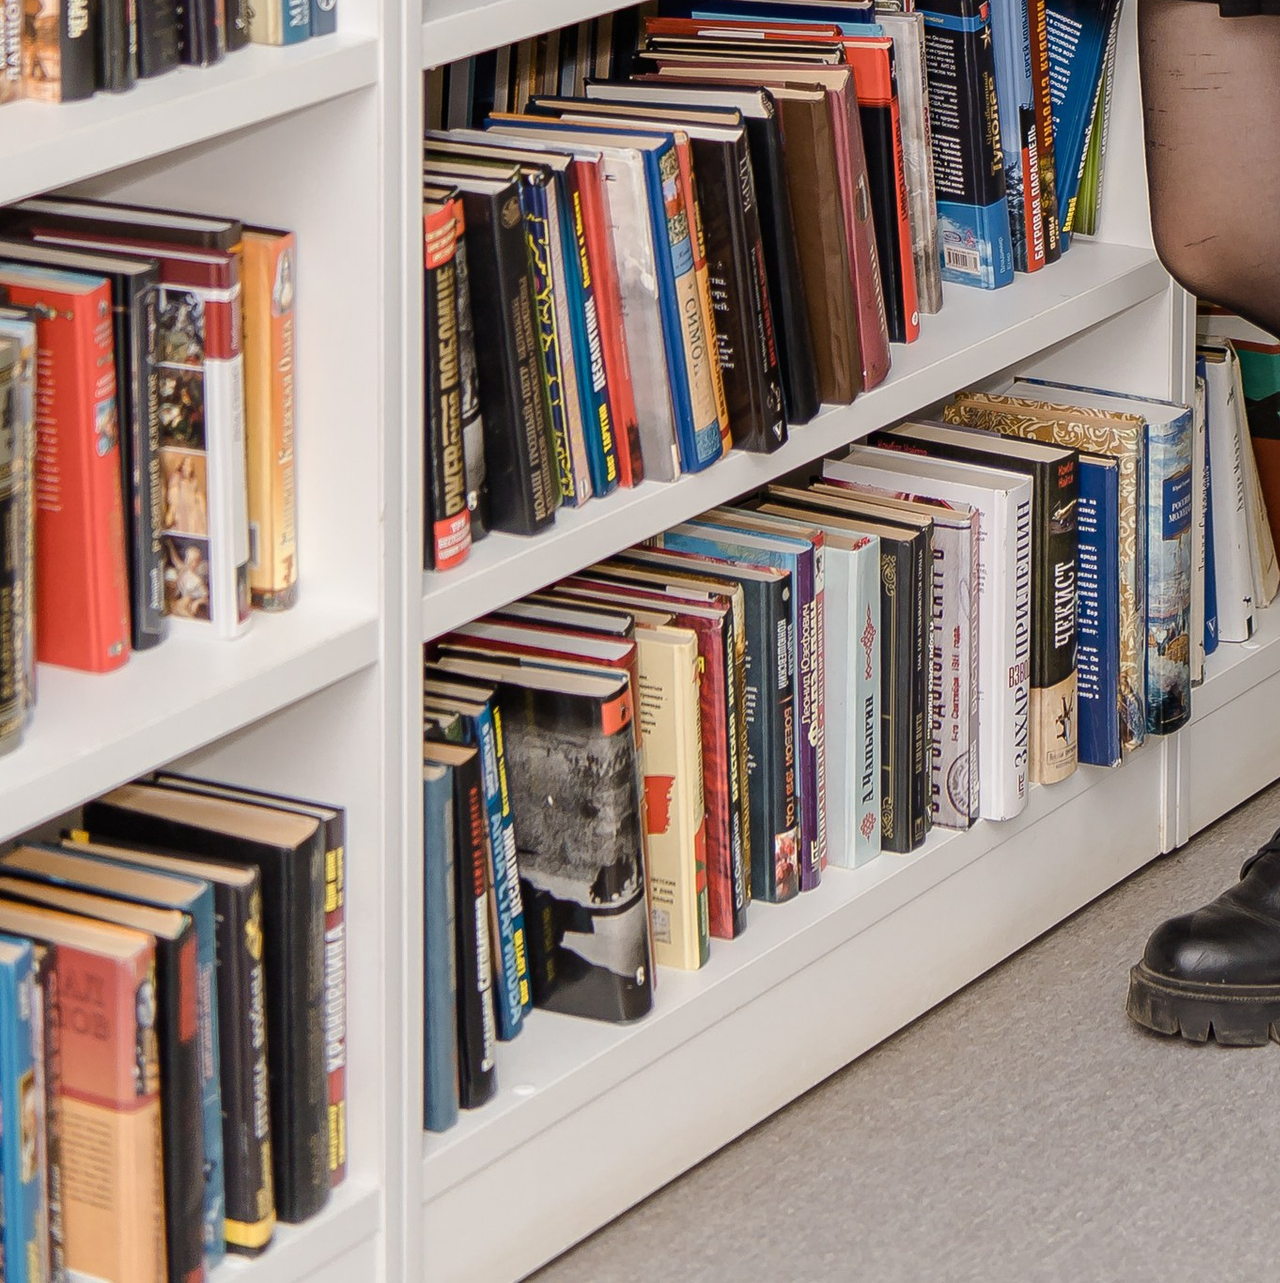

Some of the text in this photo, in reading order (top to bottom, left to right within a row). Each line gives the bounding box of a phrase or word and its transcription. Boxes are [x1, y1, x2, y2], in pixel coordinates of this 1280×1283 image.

[981, 74, 1004, 178] Туполев
[1041, 77, 1054, 148] СТРОЧКА
[1025, 124, 1044, 262] БАГРОВАЯ ПАРАЛЛЕЛЬ
[584, 294, 607, 395] ДЕСАНТНИК
[597, 403, 617, 483] Олег ТАРУГИН
[1012, 499, 1032, 770] ЗАХАР ПРИЛЕПИН
[1052, 559, 1076, 651] ЧЕКИСТ
[726, 623, 741, 803] БРЕСТСКАЯ КРЕПОСТЬ
[799, 602, 813, 725] Леонид Юзефович
[784, 705, 796, 829] БОЕВОЙ ГОД
[502, 822, 524, 918] ДЕСАНТНИК
